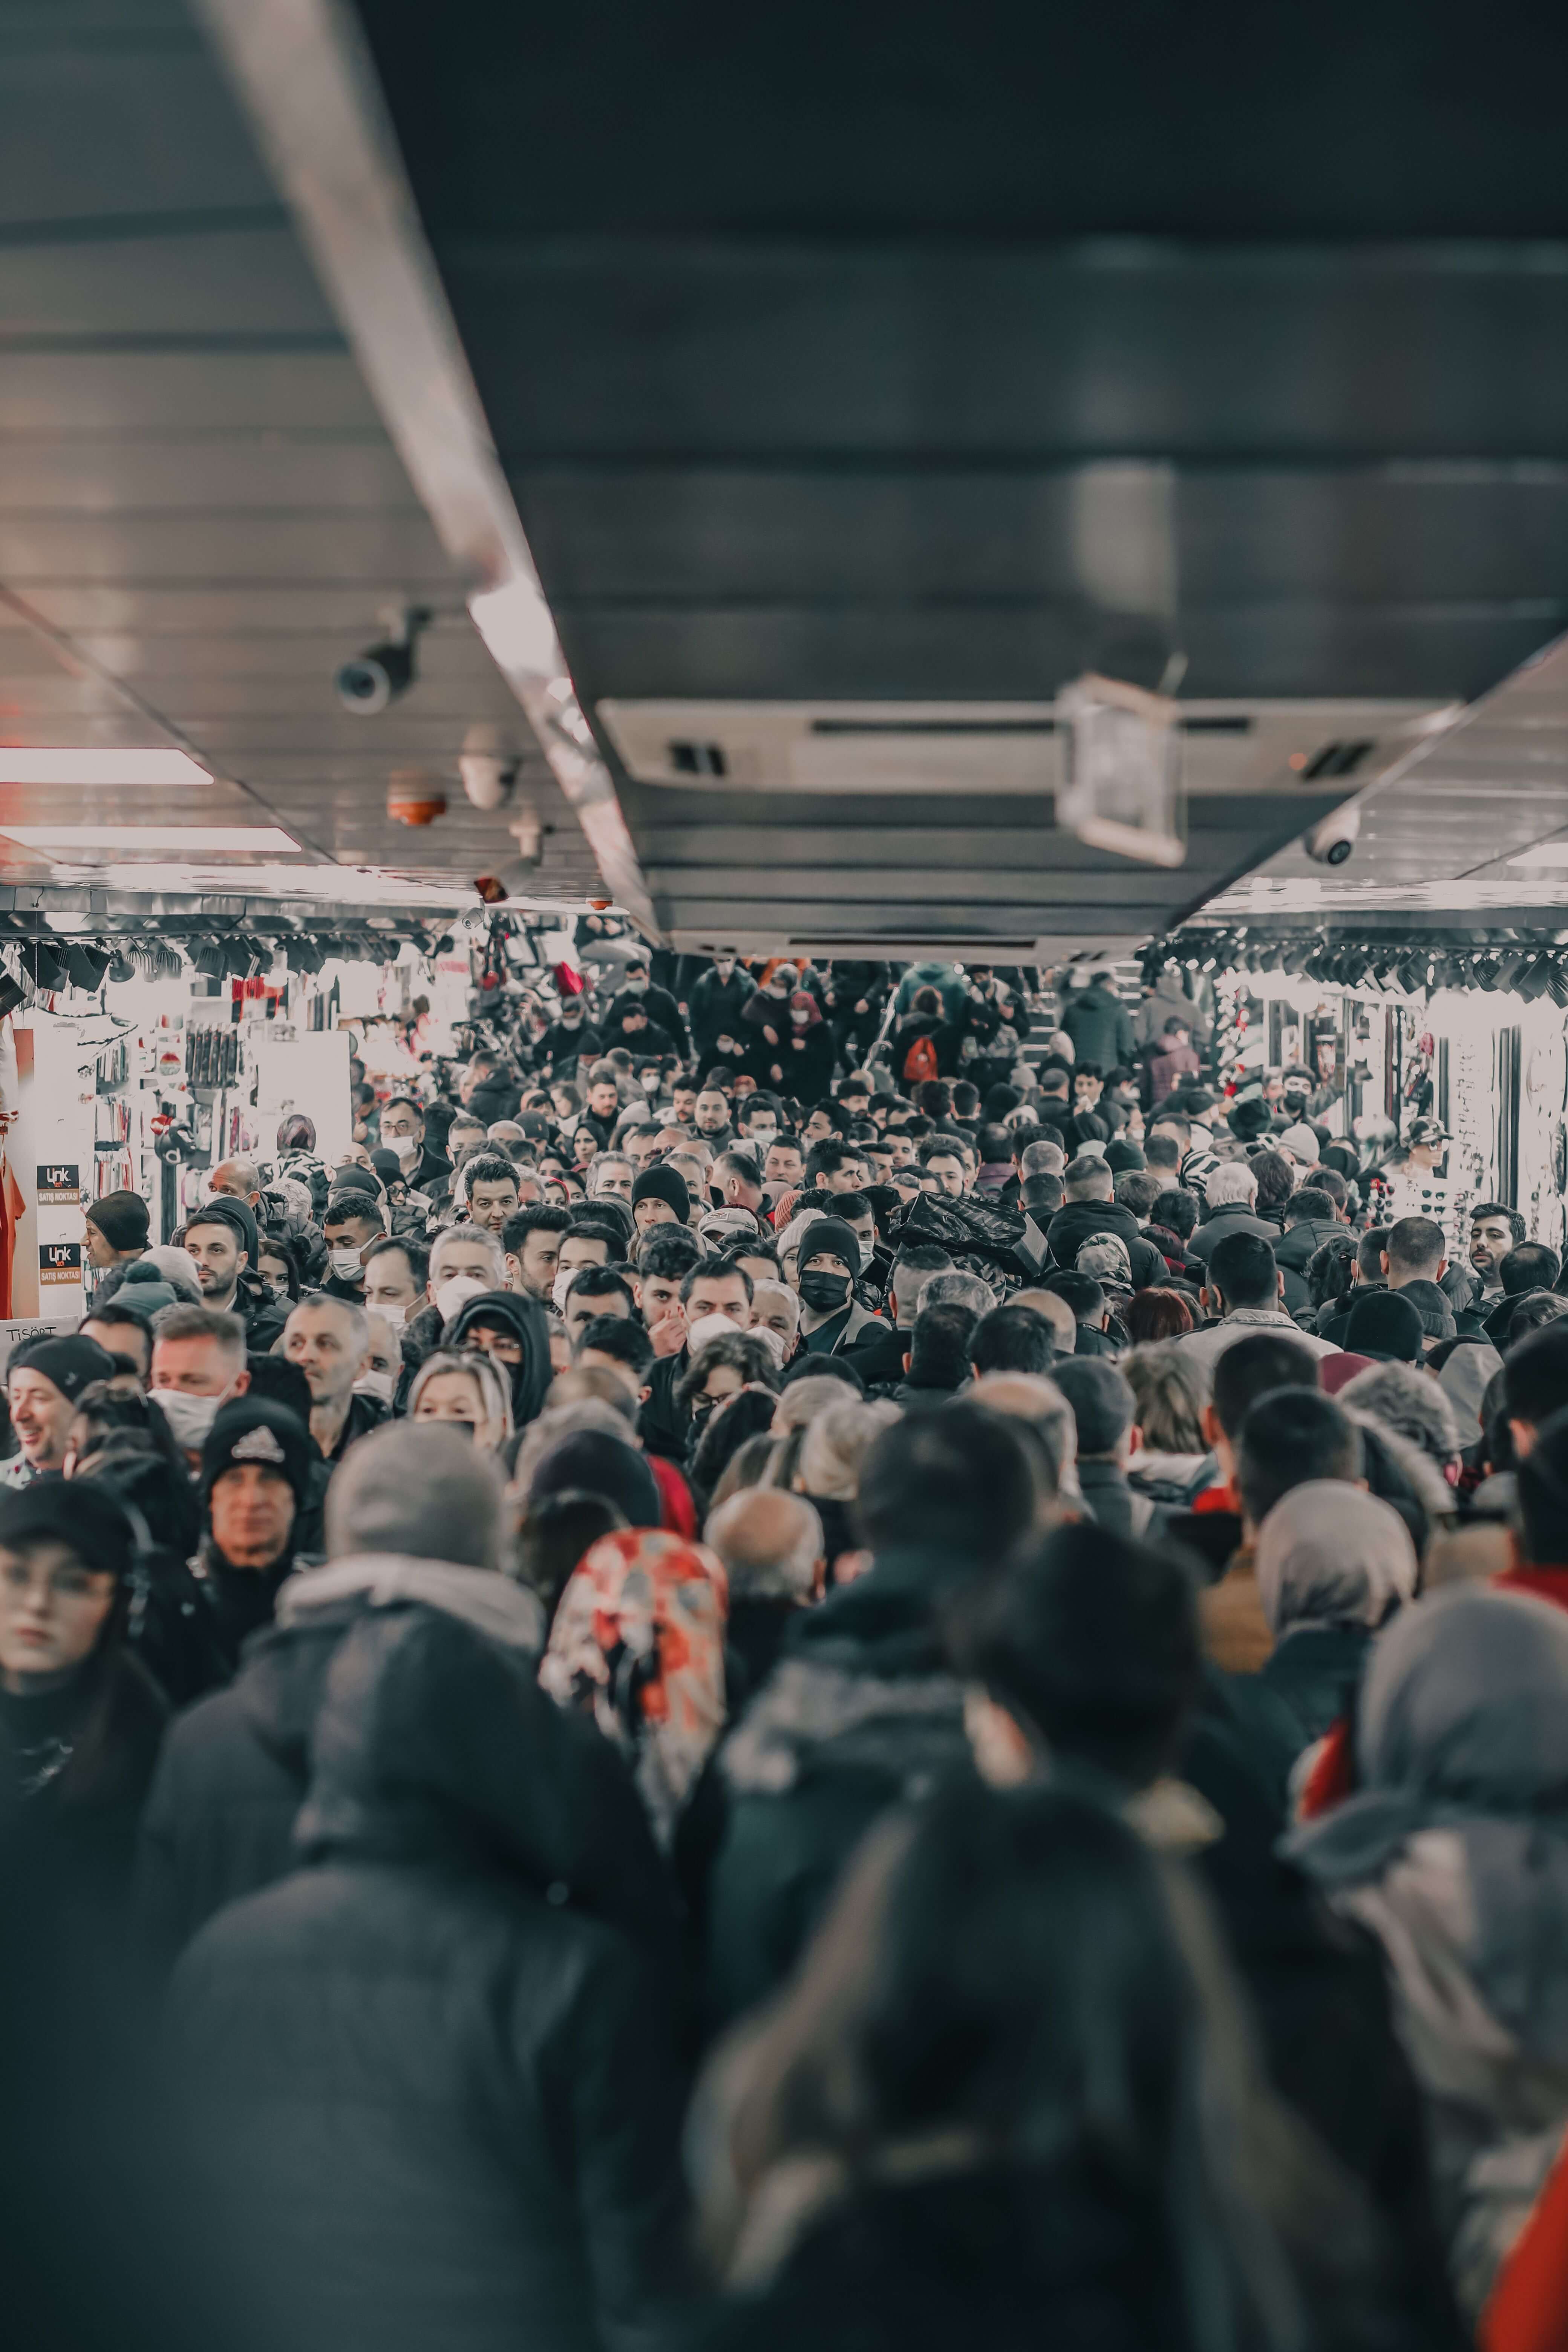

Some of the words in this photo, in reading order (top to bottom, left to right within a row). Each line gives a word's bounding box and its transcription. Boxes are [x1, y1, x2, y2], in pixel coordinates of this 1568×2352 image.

[39, 1193, 54, 1203] SATIŞ
[55, 1192, 78, 1201] NOKTASI
[41, 1272, 56, 1282] SATIŞ
[57, 1271, 80, 1280] NOKTASI
